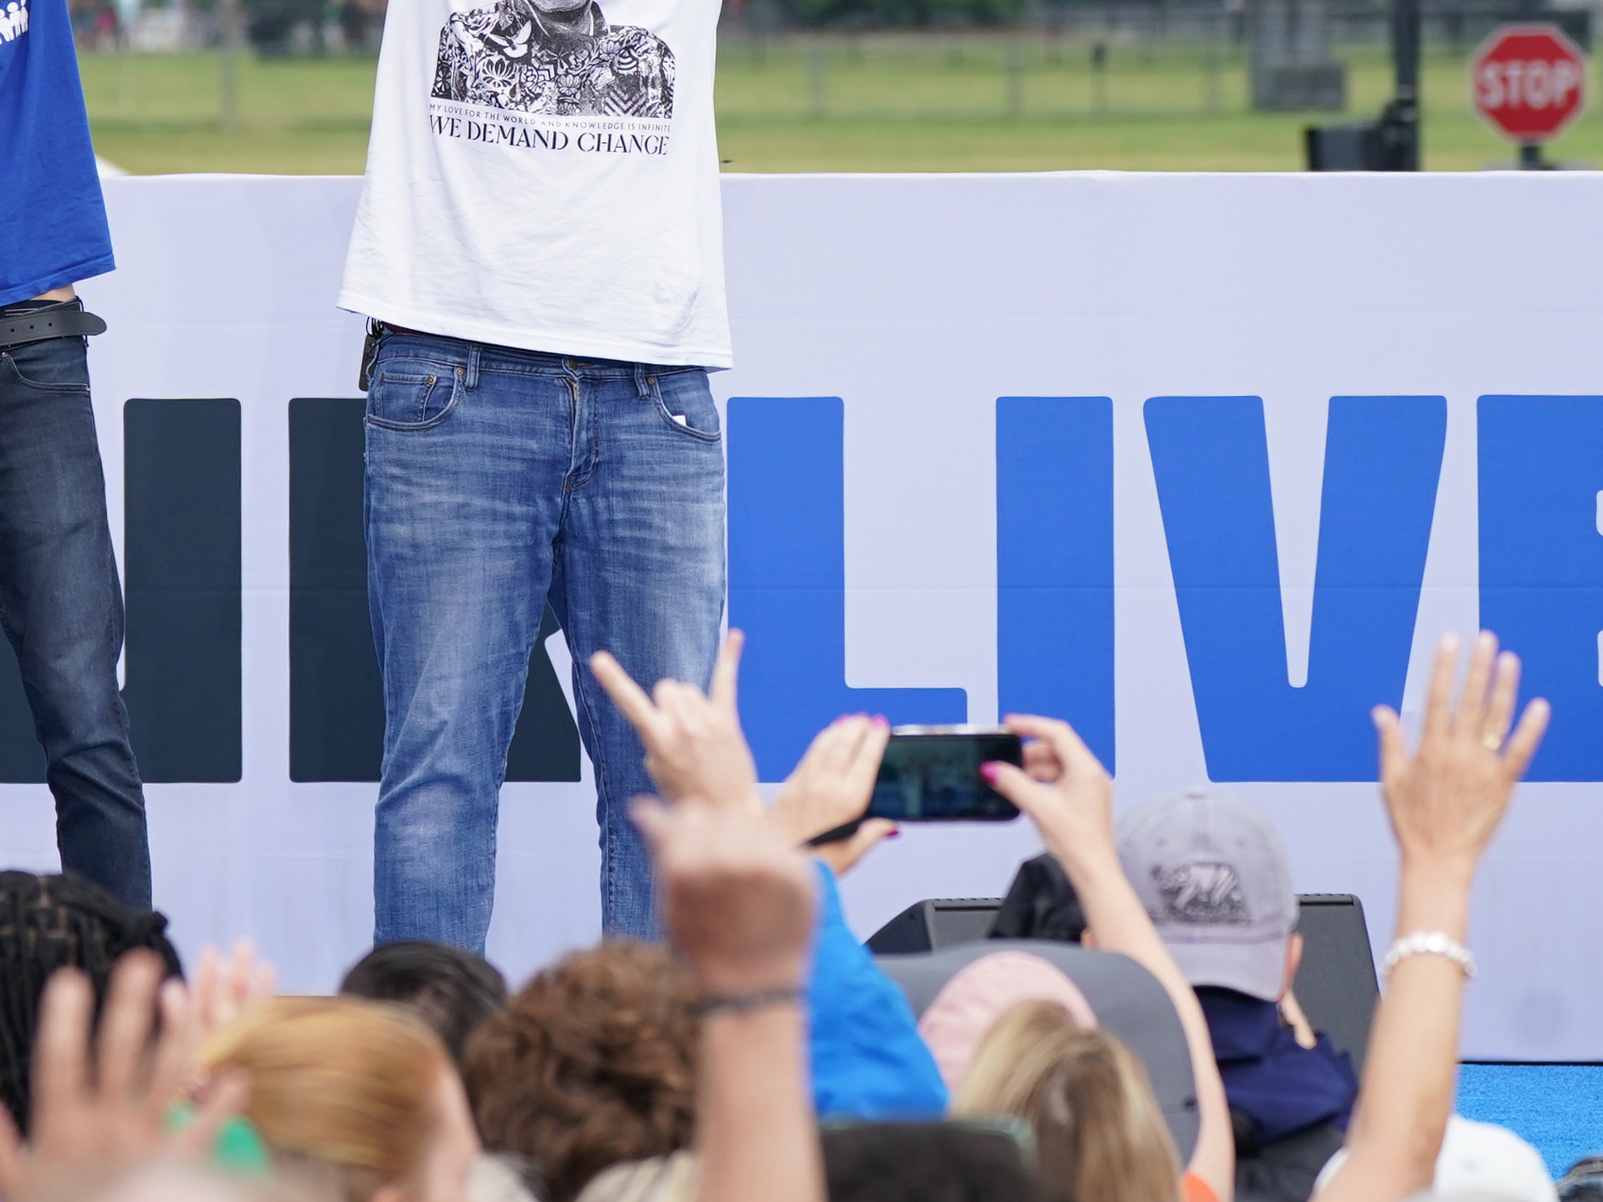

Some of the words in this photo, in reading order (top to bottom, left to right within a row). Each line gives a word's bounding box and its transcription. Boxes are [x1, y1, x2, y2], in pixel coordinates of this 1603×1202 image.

[1478, 59, 1579, 110] STOP
[429, 114, 462, 138] WE
[467, 121, 569, 151] DEMAND
[577, 132, 670, 156] CHANGE
[430, 103, 442, 112] MY
[444, 105, 464, 116] LOVE
[465, 107, 482, 118] FOR
[484, 110, 501, 121] THE
[503, 114, 537, 126] WORLD
[540, 120, 563, 128] AND
[565, 122, 625, 130] KNOWLEDGE
[638, 123, 672, 133] INFINITE
